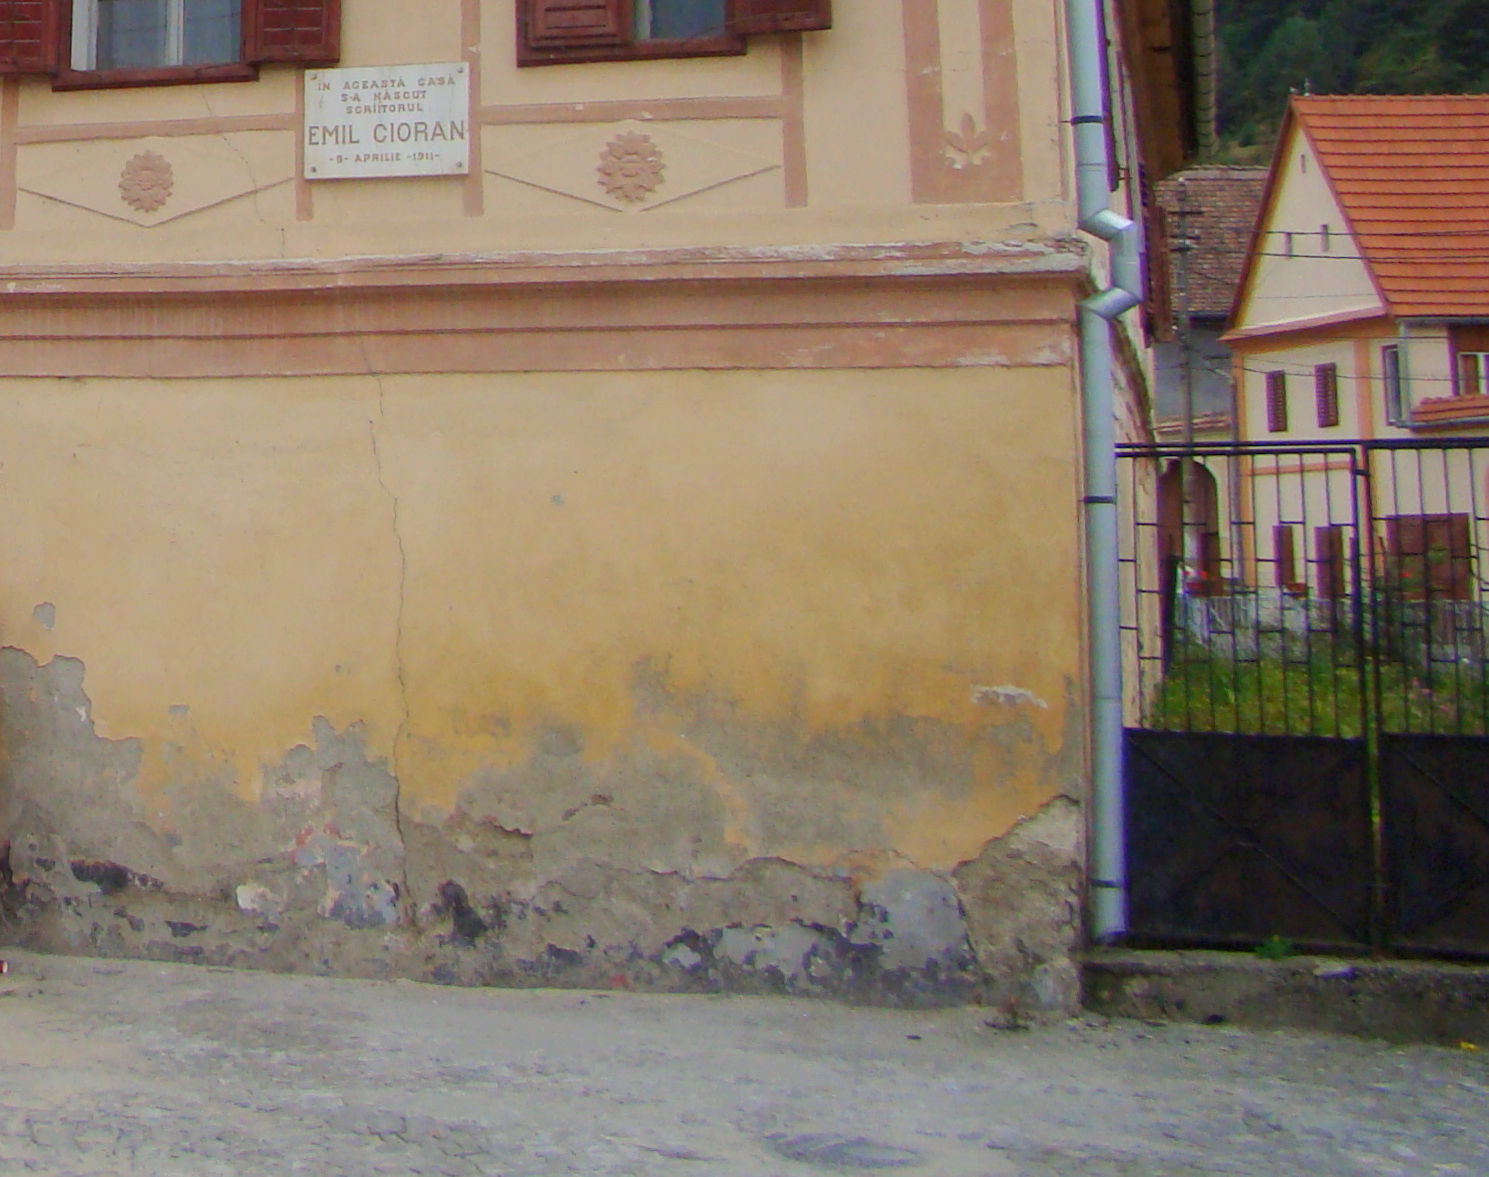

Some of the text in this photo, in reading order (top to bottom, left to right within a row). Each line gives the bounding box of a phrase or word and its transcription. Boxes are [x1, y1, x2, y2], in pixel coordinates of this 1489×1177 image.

[341, 93, 361, 102] S-A
[346, 103, 423, 114] SCRIITORUL
[308, 120, 465, 145] EMIL CIORAN
[354, 152, 401, 163] APRILIE
